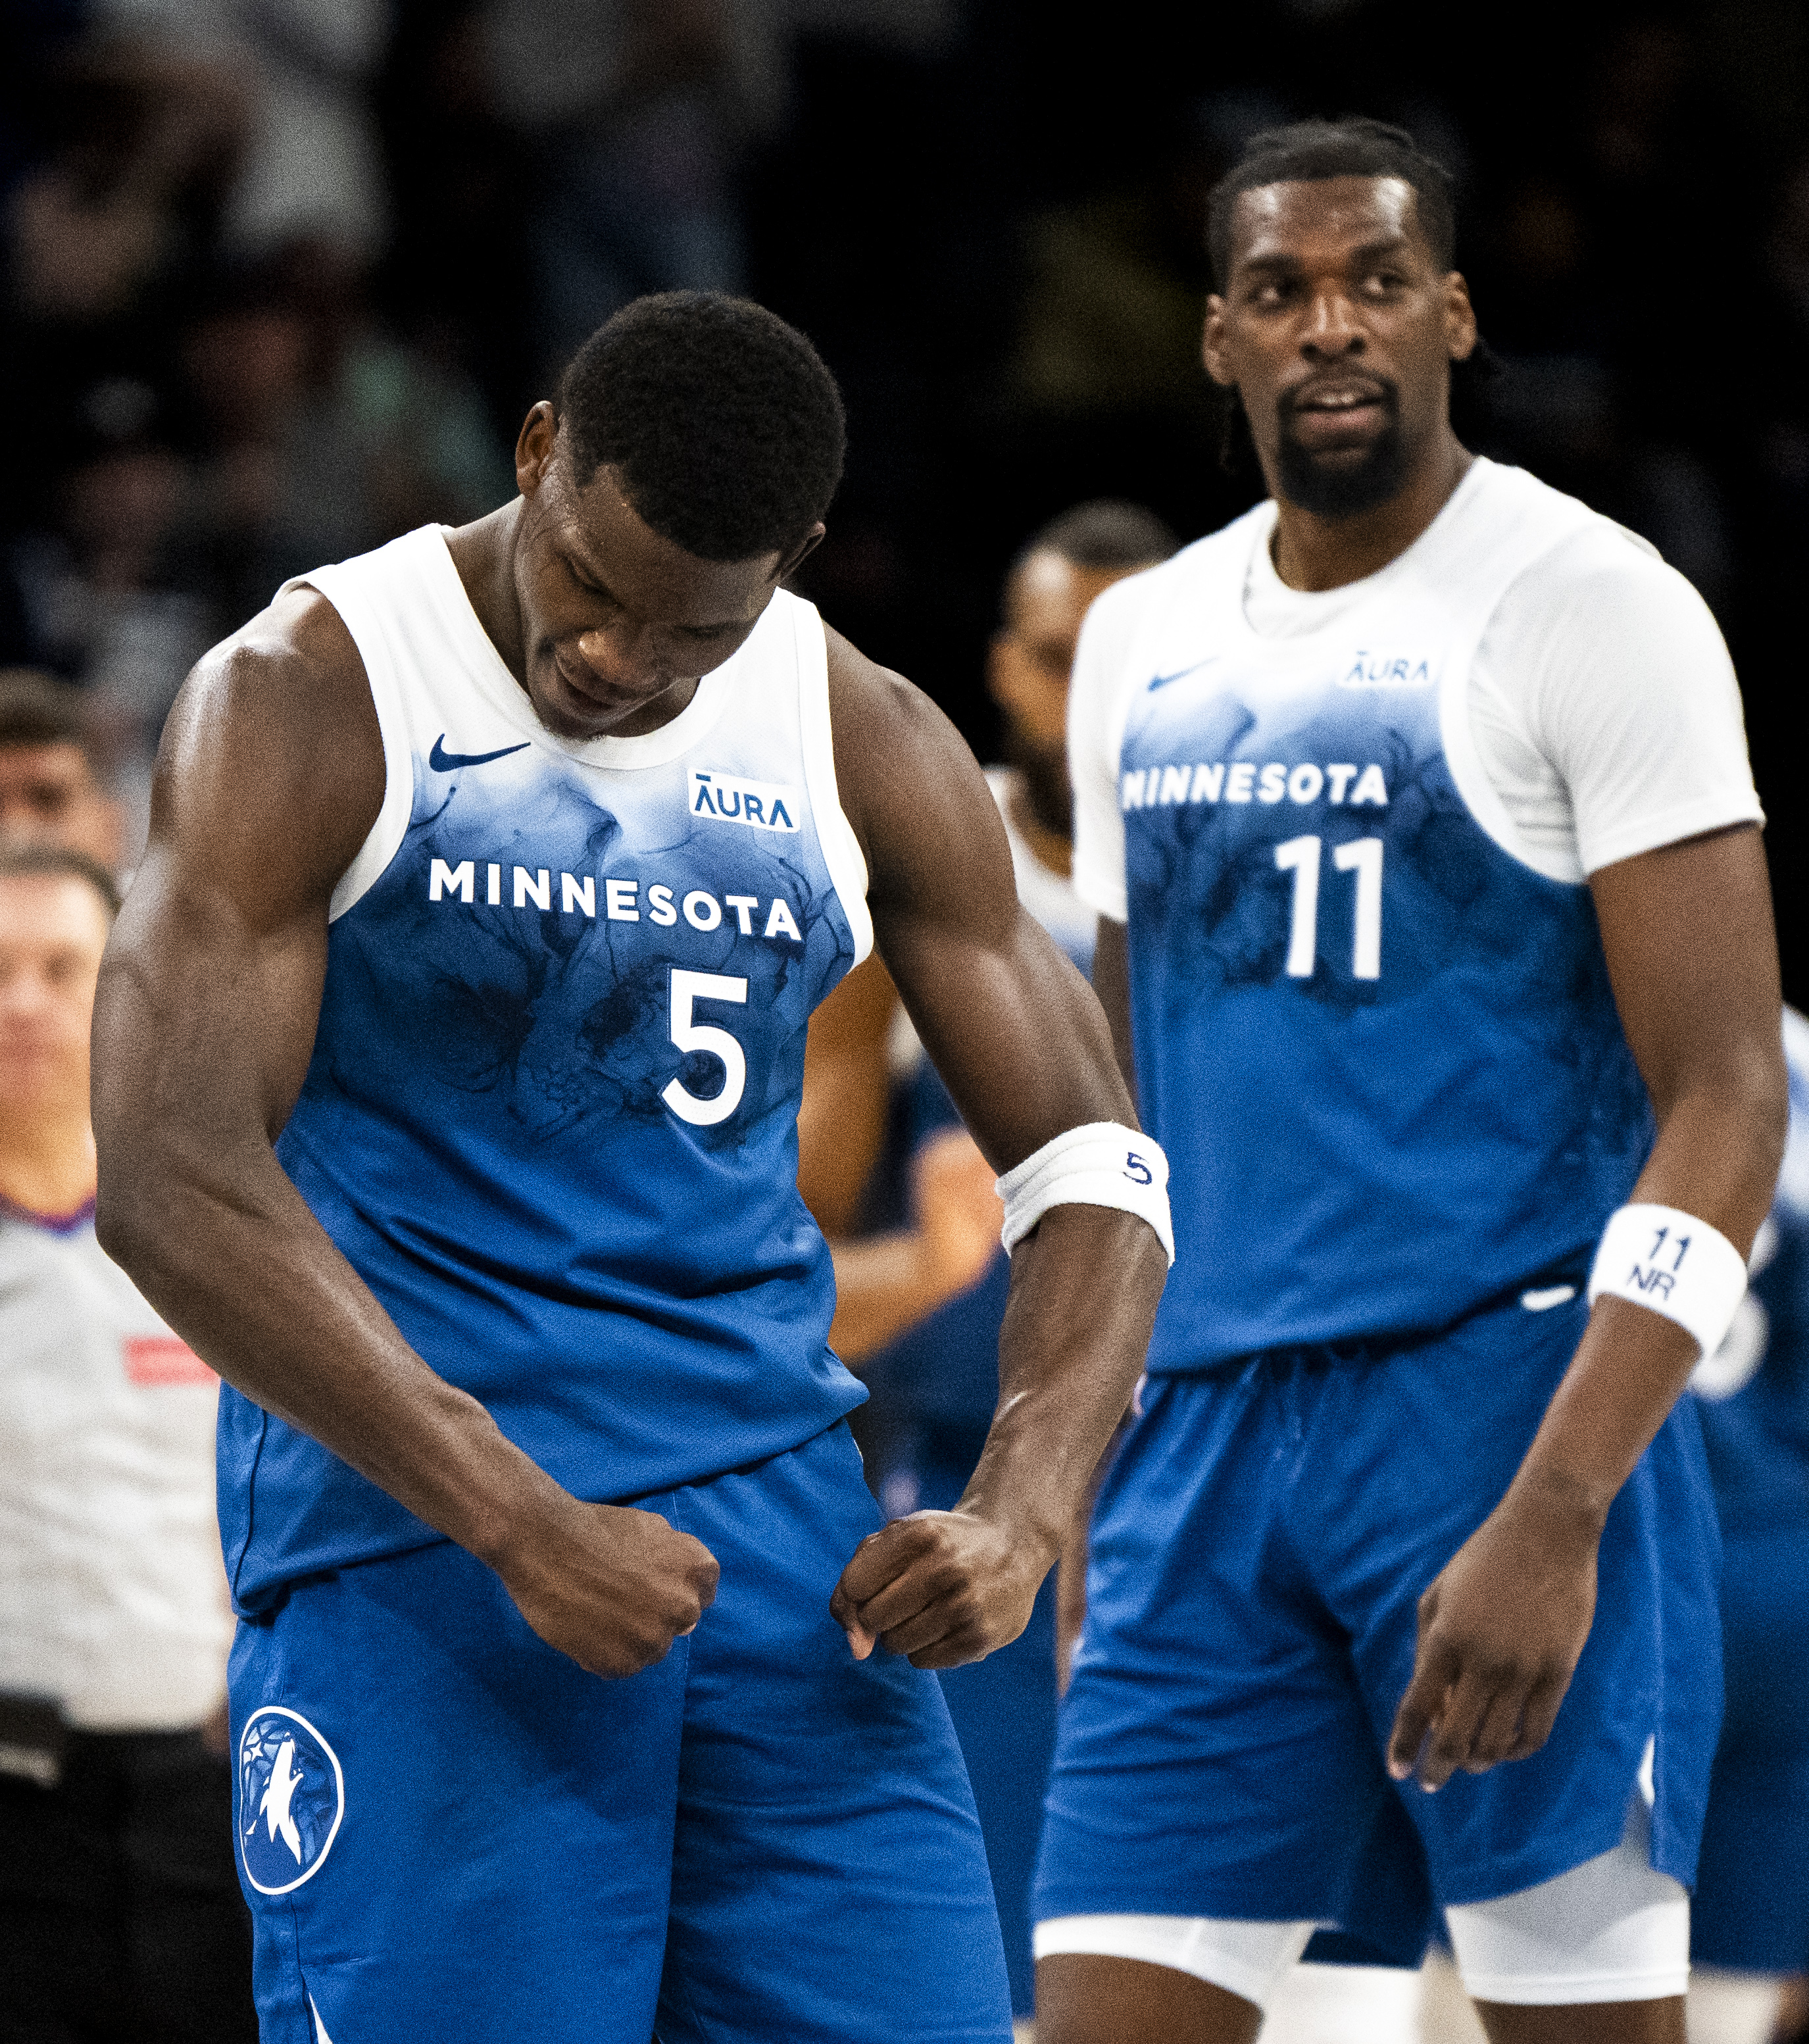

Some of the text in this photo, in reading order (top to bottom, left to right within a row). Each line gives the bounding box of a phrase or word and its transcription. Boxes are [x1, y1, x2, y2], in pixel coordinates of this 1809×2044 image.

[1122, 763, 1388, 810] MINNESOTA
[428, 858, 802, 941] MINNESOTA
[1276, 835, 1383, 980] 11
[661, 968, 747, 1126] 5
[1123, 1152, 1152, 1185] 5
[1649, 1226, 1692, 1271] 11
[1628, 1264, 1676, 1301] NR
